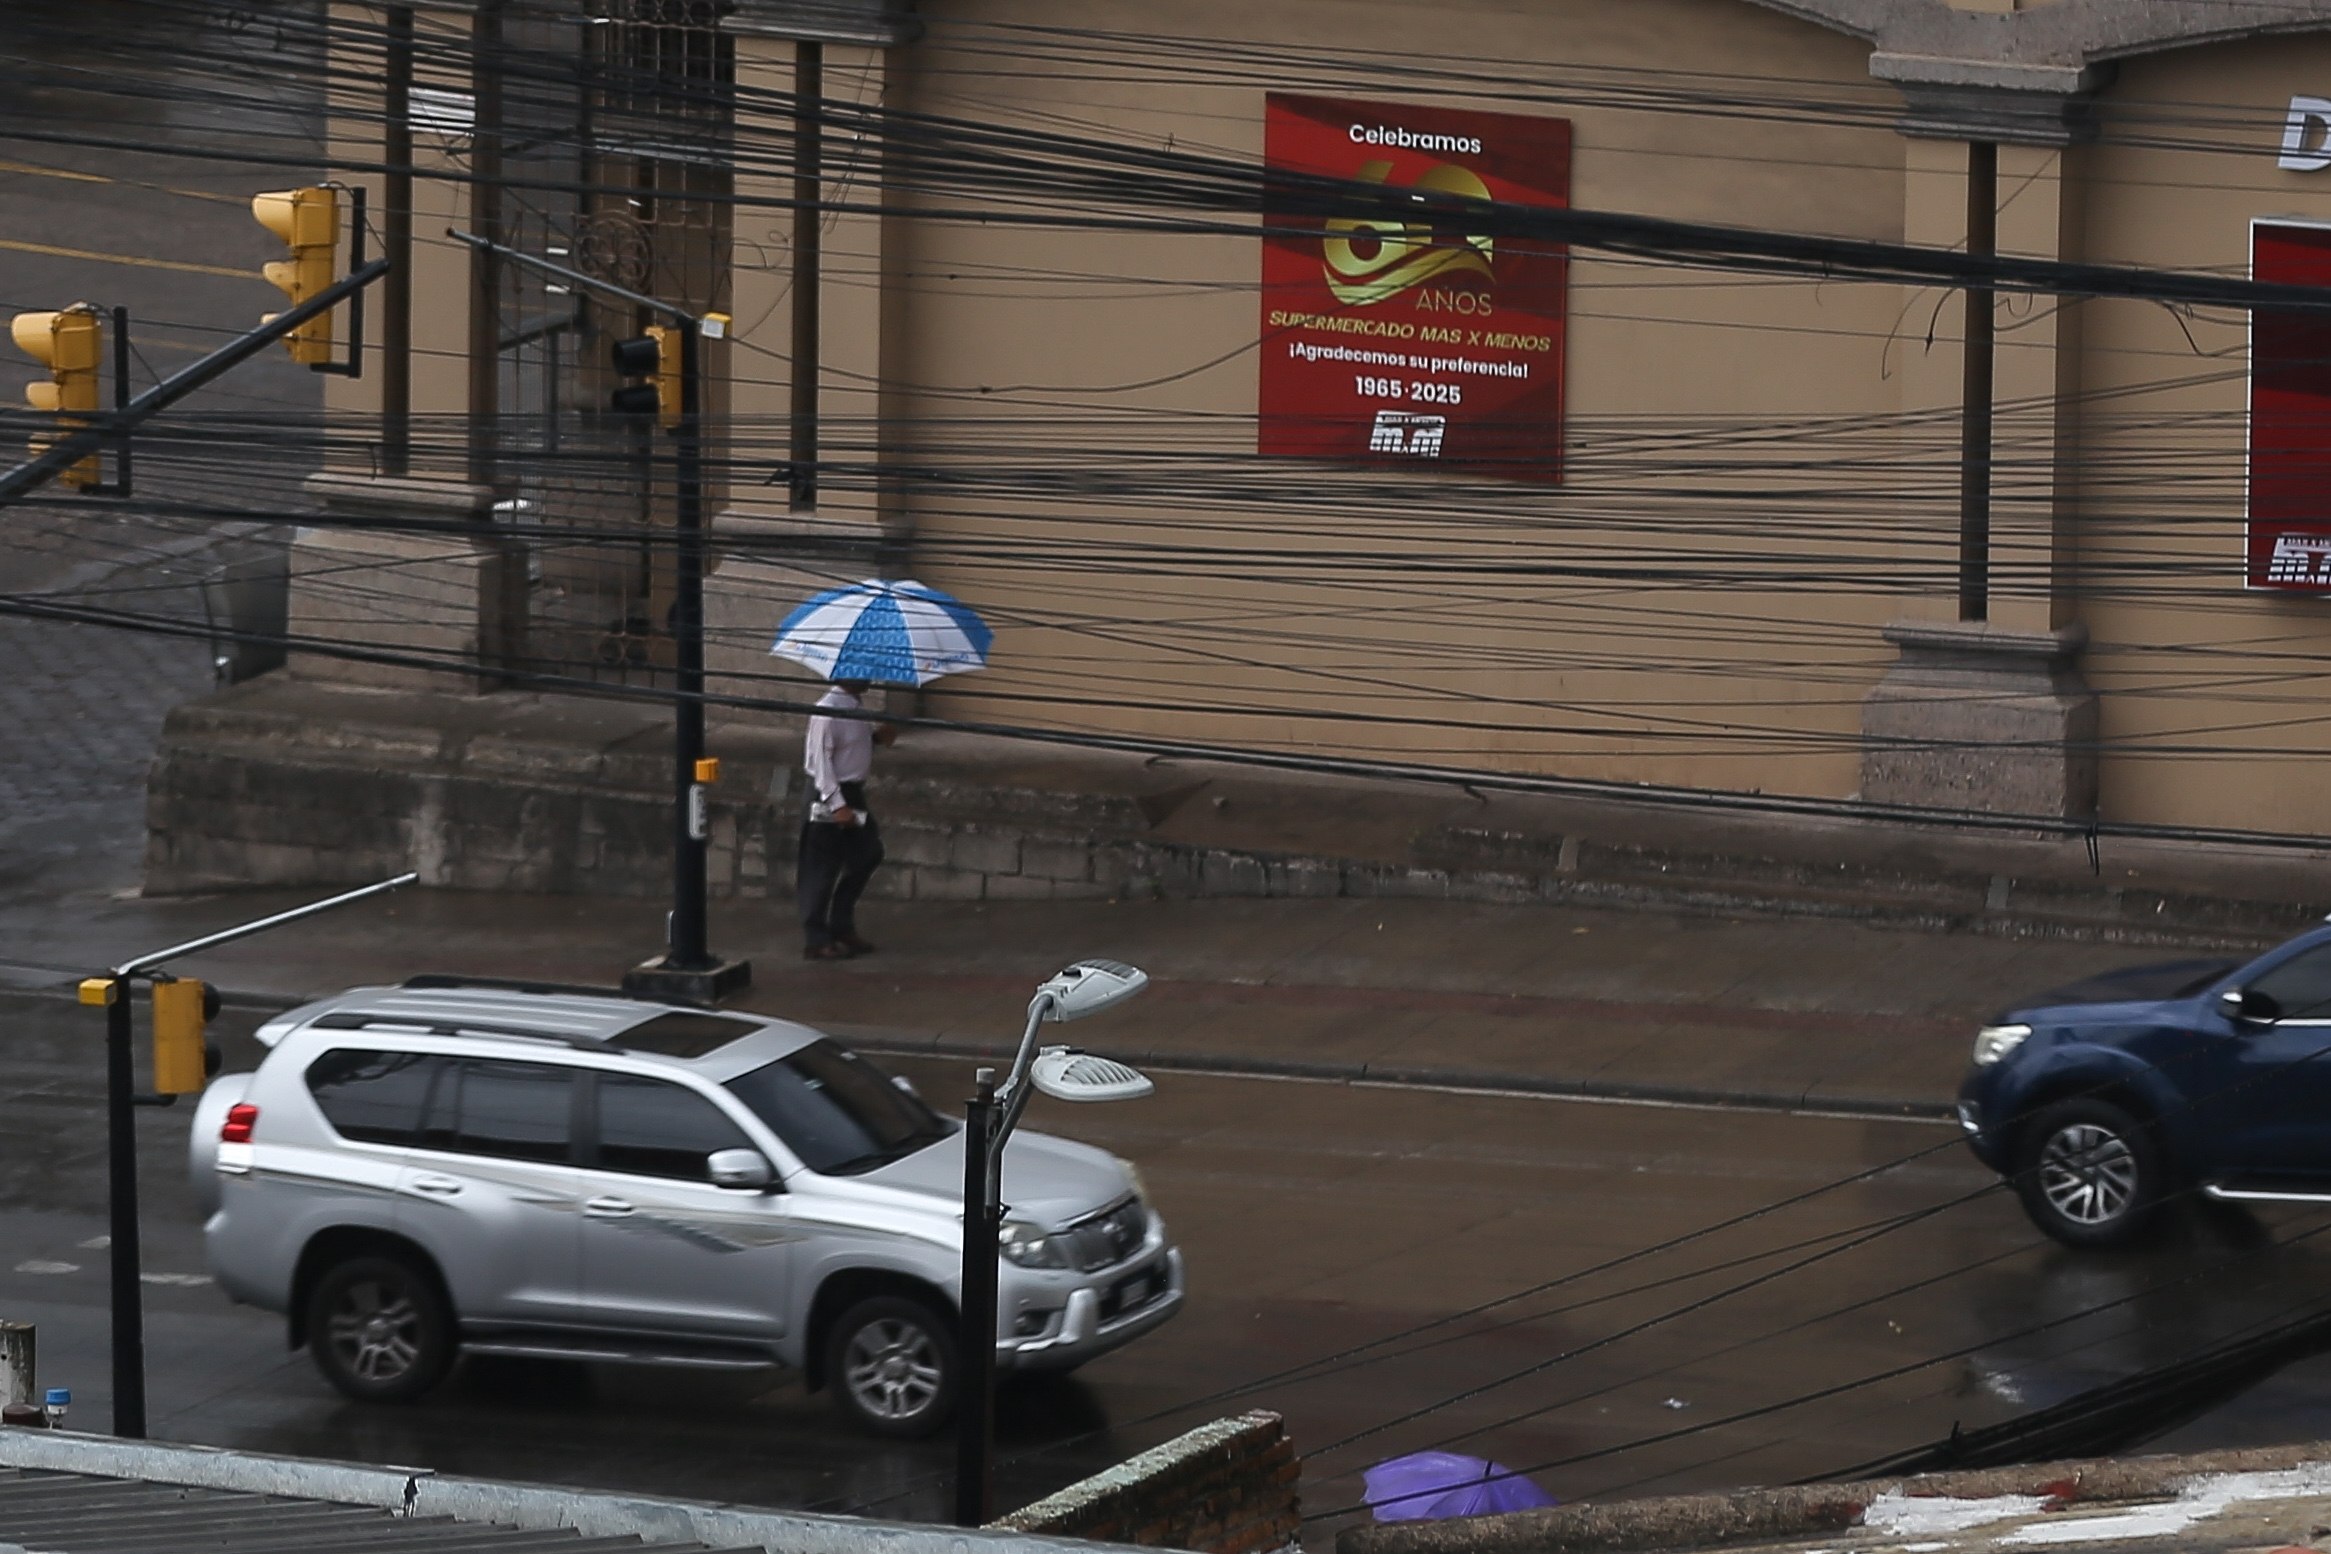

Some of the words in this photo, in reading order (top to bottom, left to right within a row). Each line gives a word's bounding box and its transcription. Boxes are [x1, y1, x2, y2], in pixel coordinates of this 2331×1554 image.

[1350, 124, 1482, 153] Celebramos
[1269, 310, 1415, 339] SUPERMERCADO
[1420, 325, 1462, 344] MAS
[1467, 329, 1482, 347] X
[1485, 331, 1552, 352] MENOS
[1409, 354, 1429, 369] su
[1431, 356, 1529, 379] preferencia!
